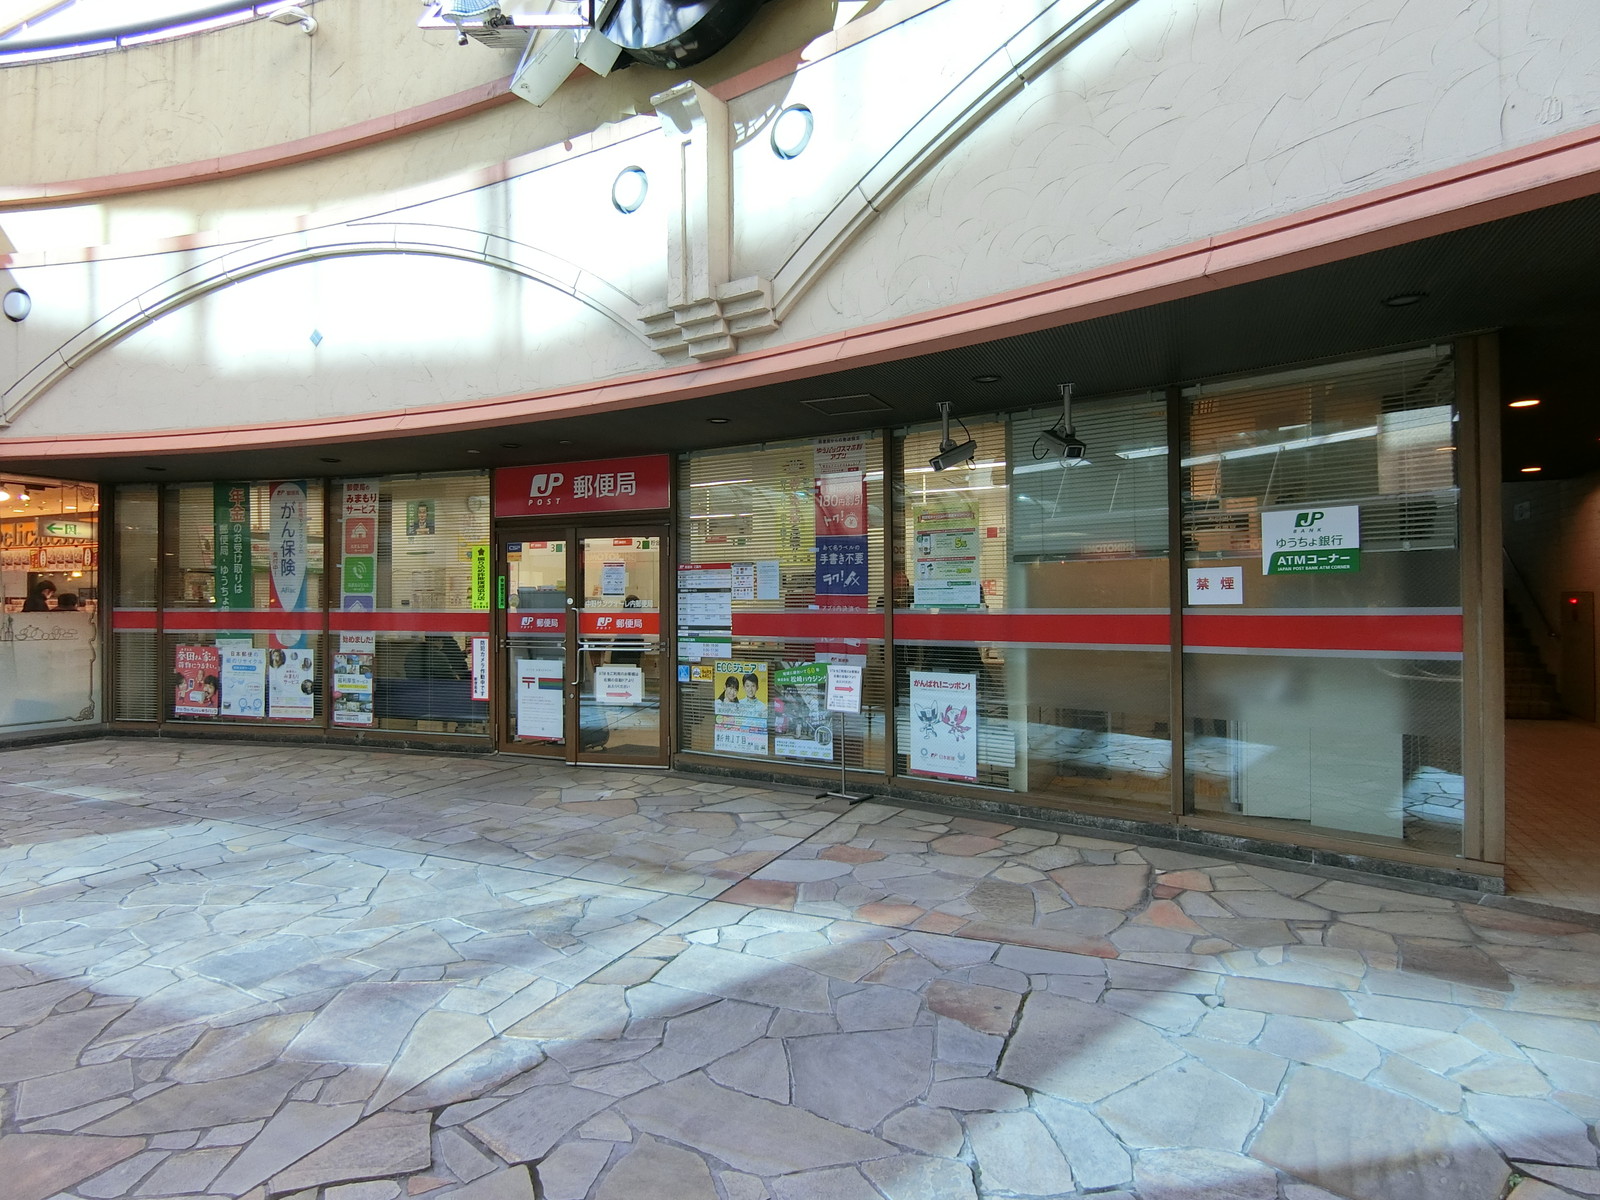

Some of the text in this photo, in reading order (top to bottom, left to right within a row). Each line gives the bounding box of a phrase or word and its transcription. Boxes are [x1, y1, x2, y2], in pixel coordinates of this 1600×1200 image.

[529, 471, 637, 499] JP 郵便局
[346, 493, 377, 504] みまもり
[528, 498, 561, 506] POST
[346, 505, 377, 515] サービス
[1294, 511, 1325, 528] JP
[280, 501, 296, 577] がん保険
[636, 540, 642, 549] 2
[1276, 534, 1344, 549] ゆうちょ銀行
[823, 544, 861, 552] あて名ラベルの
[820, 552, 864, 566] 手書き不要
[1277, 554, 1351, 566] ATMコーナー
[822, 570, 845, 586] ラク!
[1196, 577, 1235, 590] 禁煙
[536, 618, 559, 628] 郵便局
[615, 618, 643, 629] 郵便局
[342, 636, 373, 644] 始めました!
[716, 663, 757, 674] ECCジュニア
[913, 679, 971, 691] がんばれ!ニッポン!
